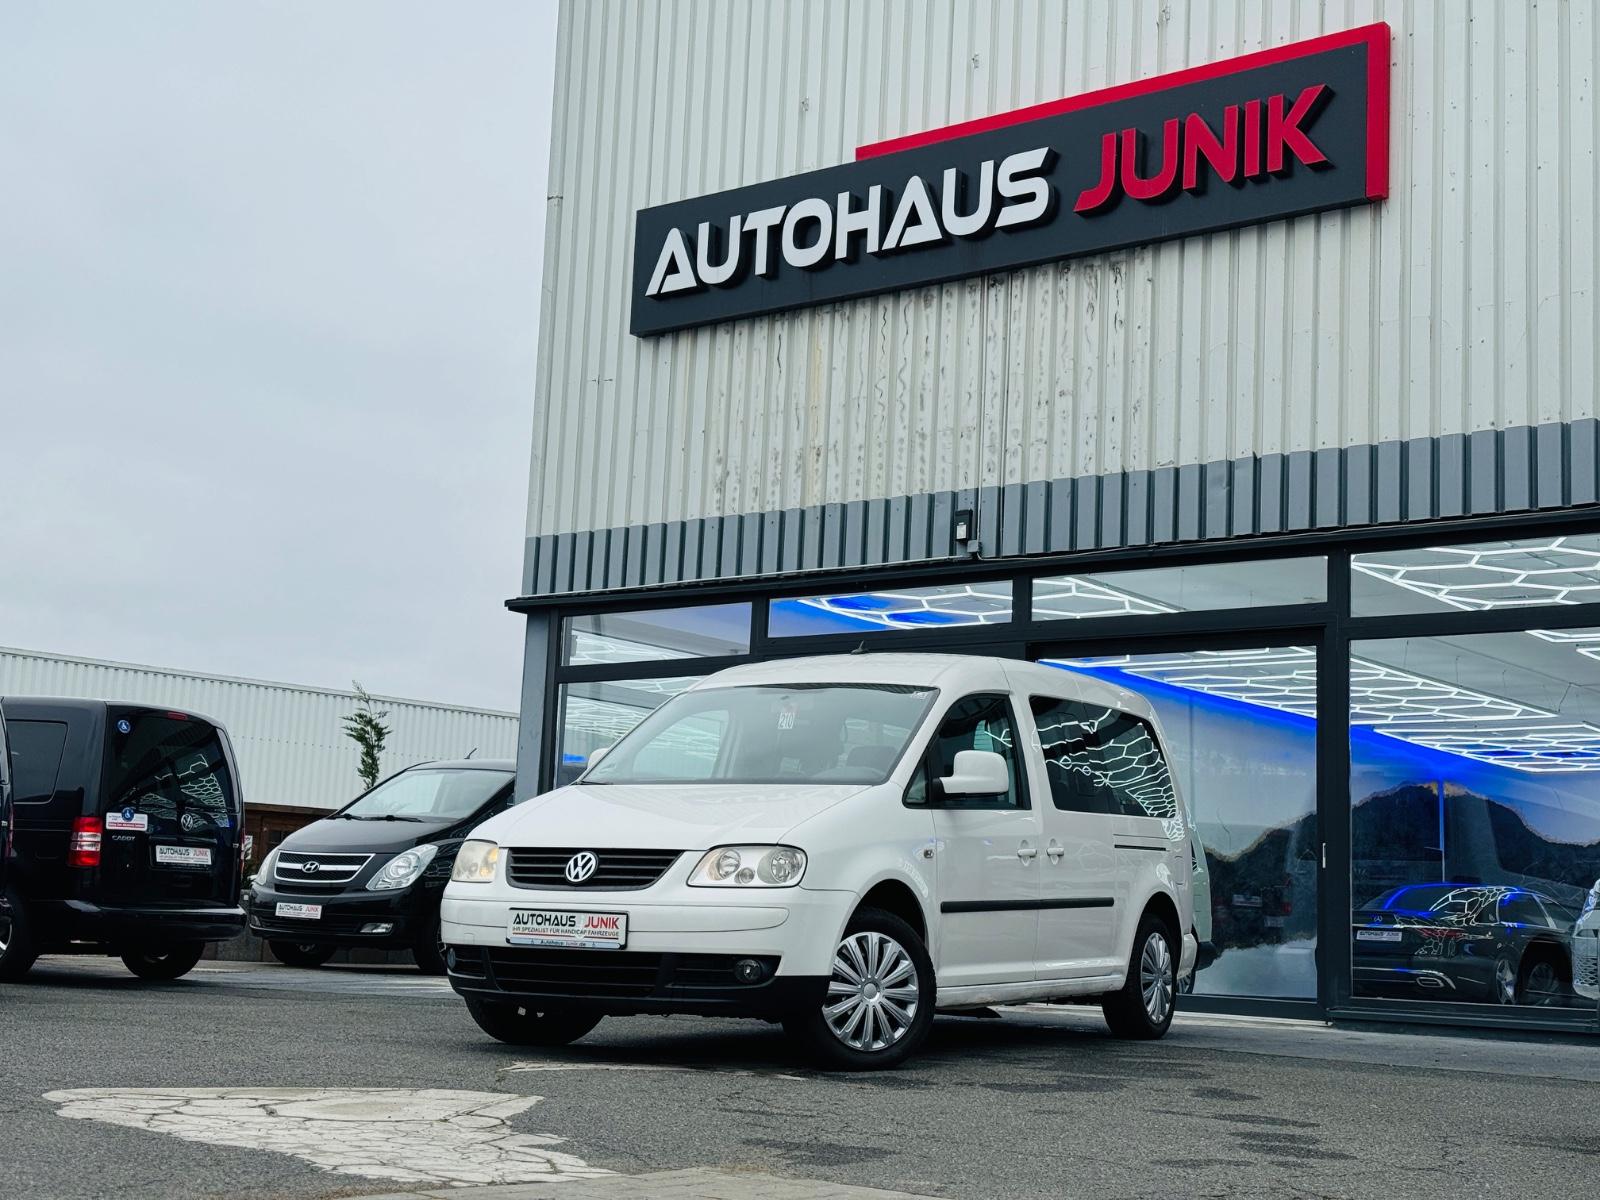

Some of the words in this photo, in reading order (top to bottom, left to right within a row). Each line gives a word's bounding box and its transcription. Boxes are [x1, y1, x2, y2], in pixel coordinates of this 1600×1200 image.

[645, 146, 1050, 297] AUTOHAUS
[1073, 83, 1329, 212] JUNIK
[159, 847, 190, 856] AUTOHAUS
[513, 912, 576, 927] AUTOHAUS
[584, 916, 620, 930] JUNIK
